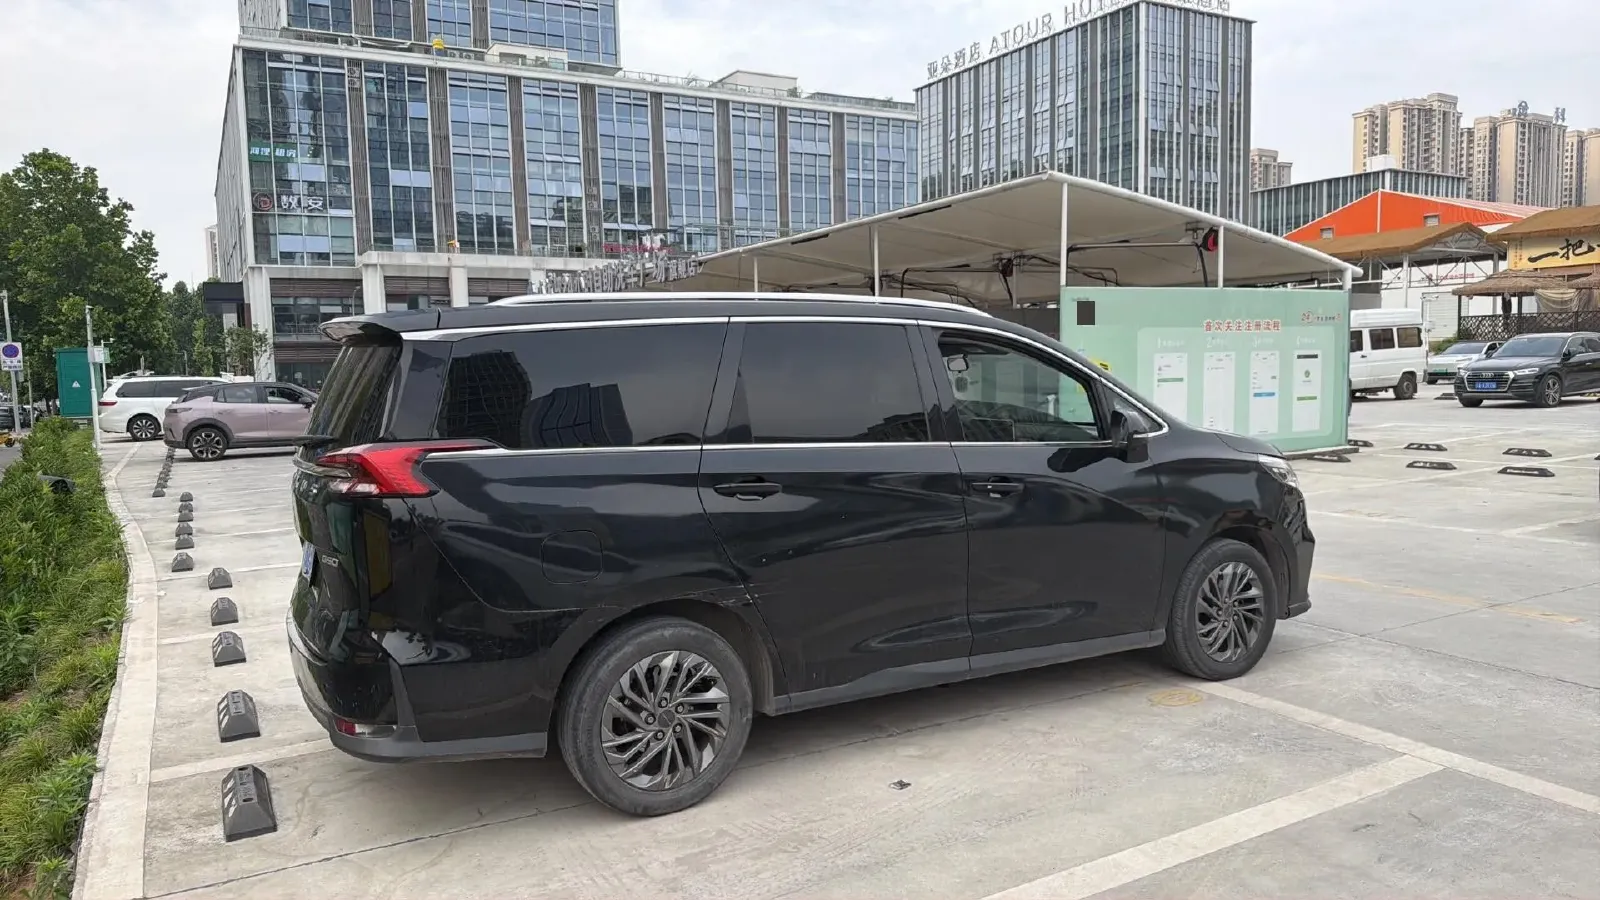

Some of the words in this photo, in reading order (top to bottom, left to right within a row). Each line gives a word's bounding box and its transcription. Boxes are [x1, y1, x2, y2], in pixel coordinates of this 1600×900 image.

[927, 41, 981, 79] 亚朵酒店
[989, 13, 1052, 54] ATOUR
[1528, 238, 1600, 263] 一把
[1204, 320, 1280, 332] 首次关注注册流程
